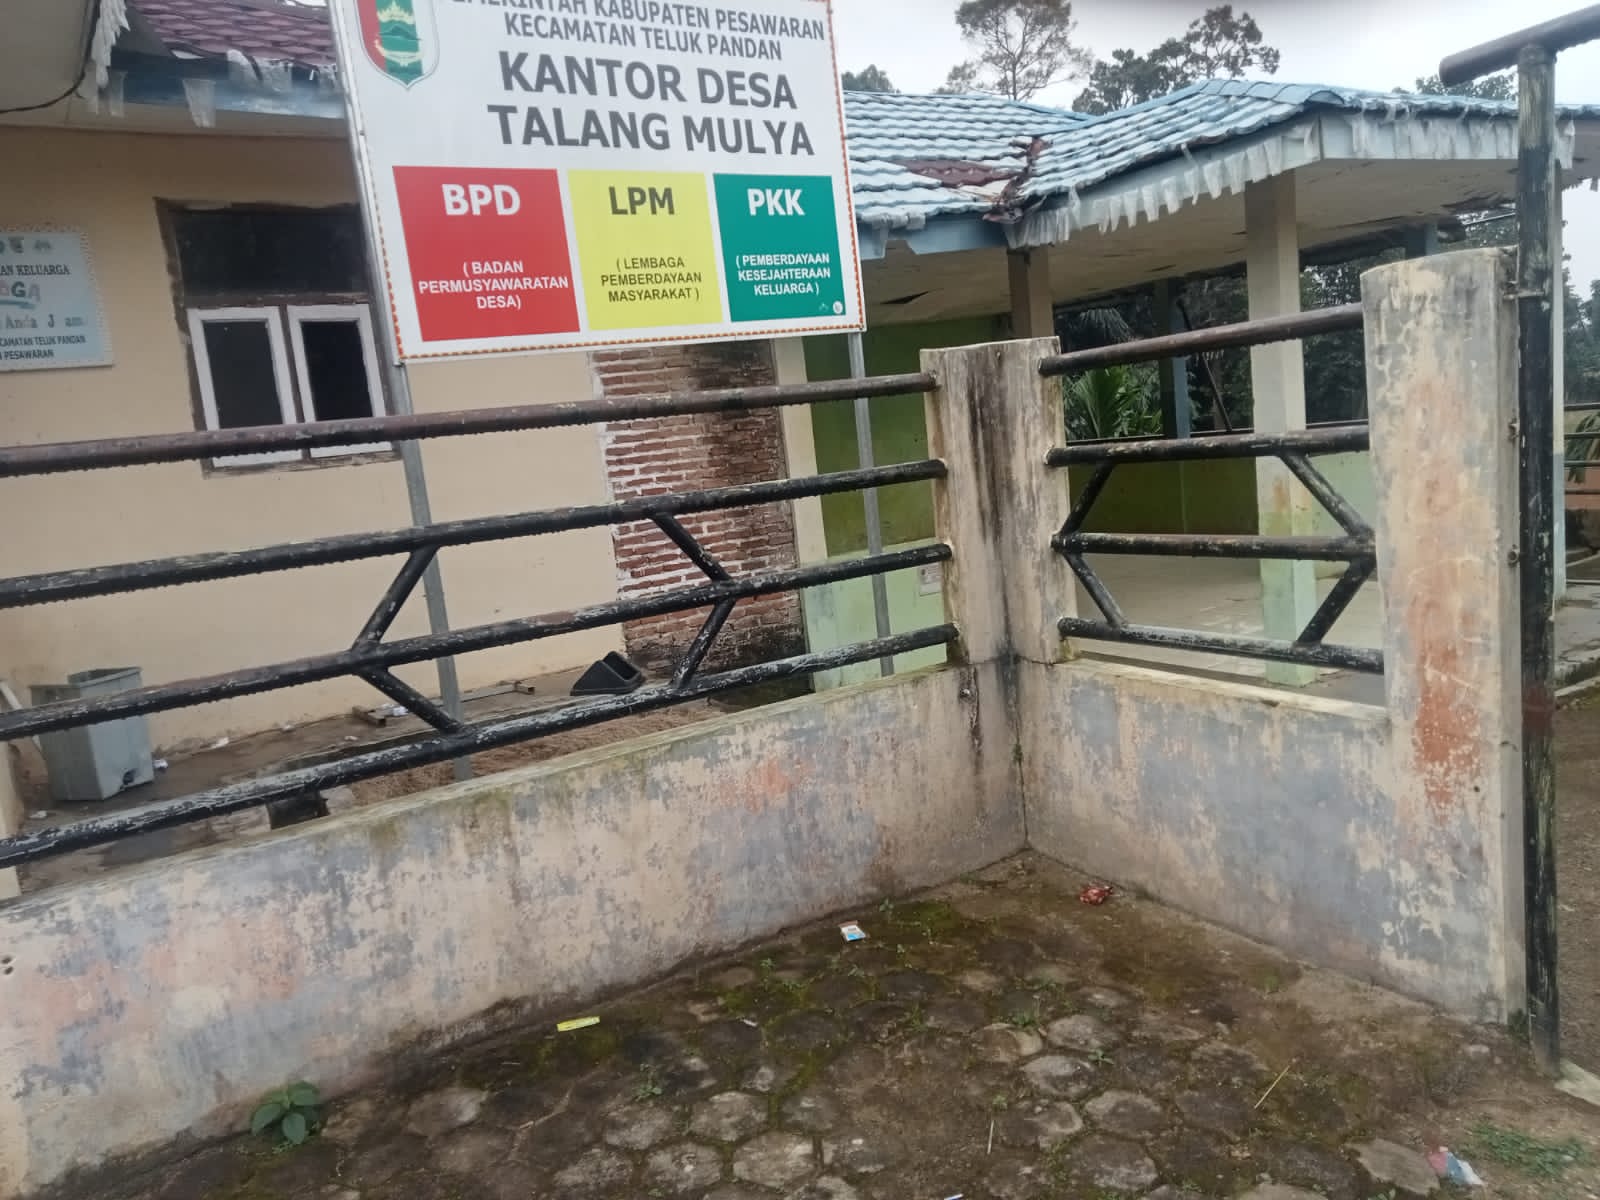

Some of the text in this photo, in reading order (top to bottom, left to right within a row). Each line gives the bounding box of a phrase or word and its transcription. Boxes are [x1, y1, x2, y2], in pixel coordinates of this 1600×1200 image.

[594, 0, 710, 29] KABUPATEN
[715, 9, 825, 40] PESAWARAN
[504, 12, 782, 60] KECAMATAN TELUK PANDAN
[498, 50, 798, 109] KANTOR DESA
[487, 104, 815, 155] TALANG MULYA
[442, 183, 521, 216] BPD
[608, 186, 675, 215] LPM
[747, 188, 805, 216] PKK
[623, 256, 685, 270] LEMBAGA
[742, 252, 831, 267] PEMBERDAYAAN
[16, 263, 71, 276] KELUARGA
[472, 260, 524, 275] BADAN
[737, 267, 832, 281] KESEJAHTERAAN
[418, 276, 569, 294] PERMUSYAWARATAN
[600, 271, 702, 287] PEMBERDAYAAN
[608, 287, 692, 302] MASYARAKAT
[753, 282, 813, 296] KELUARGA
[476, 295, 522, 310] DESA)
[4, 349, 54, 360] PESAWARAN
